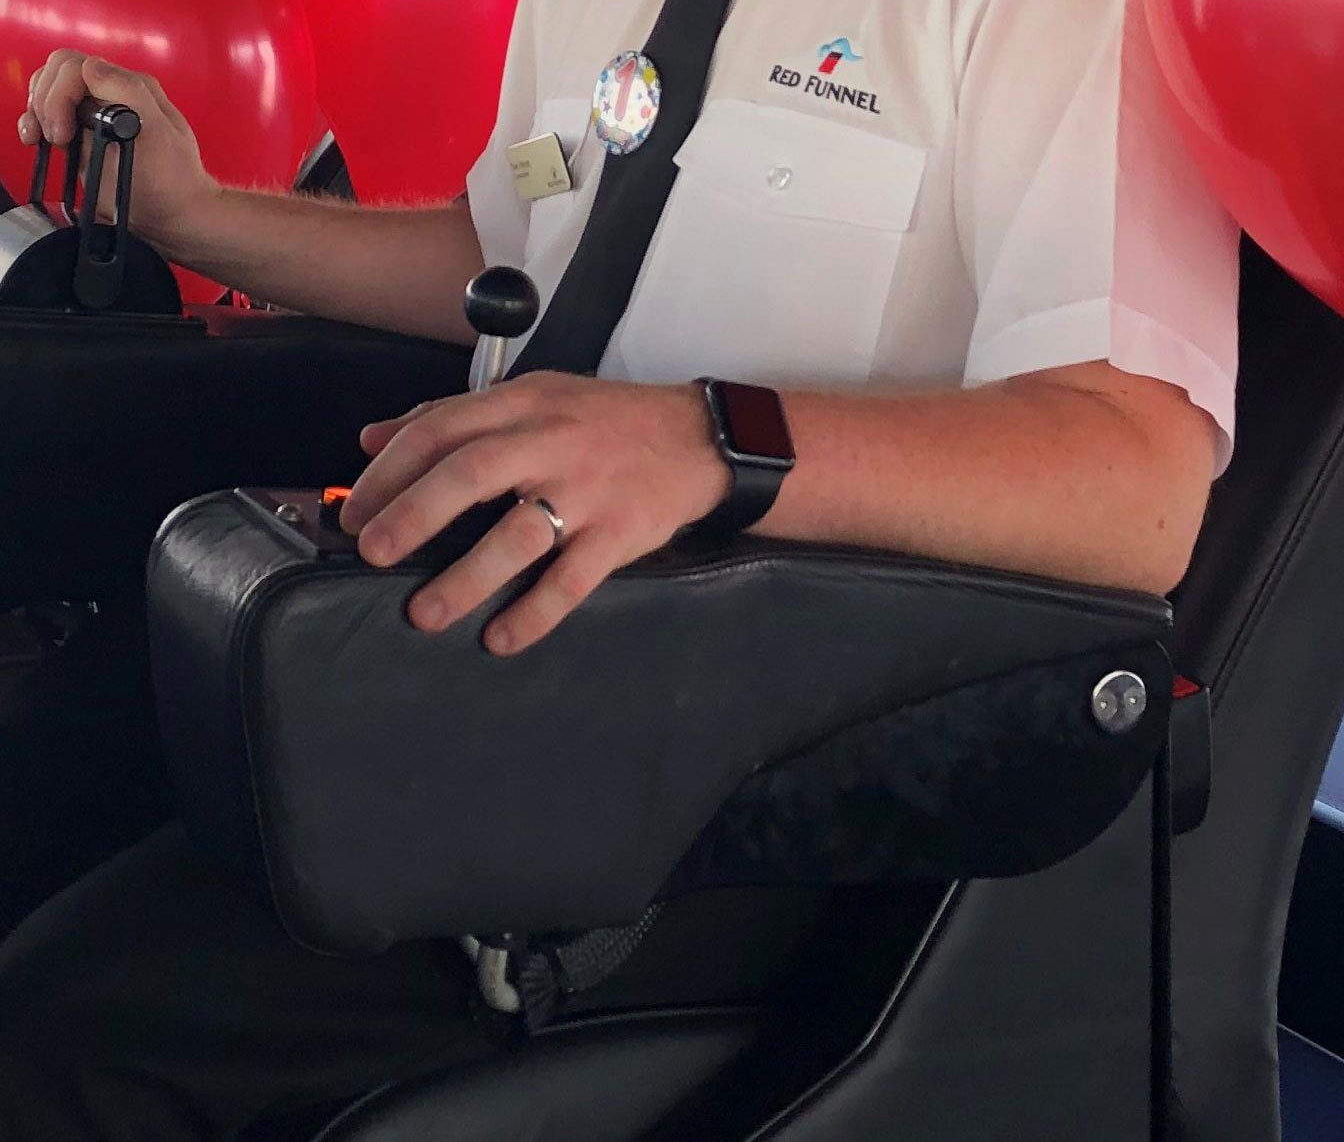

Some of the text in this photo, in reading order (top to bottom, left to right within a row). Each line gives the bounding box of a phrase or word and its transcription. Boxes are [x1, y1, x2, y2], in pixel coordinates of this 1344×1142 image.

[615, 59, 636, 121] 1
[769, 64, 880, 114] RED FUNNEL
